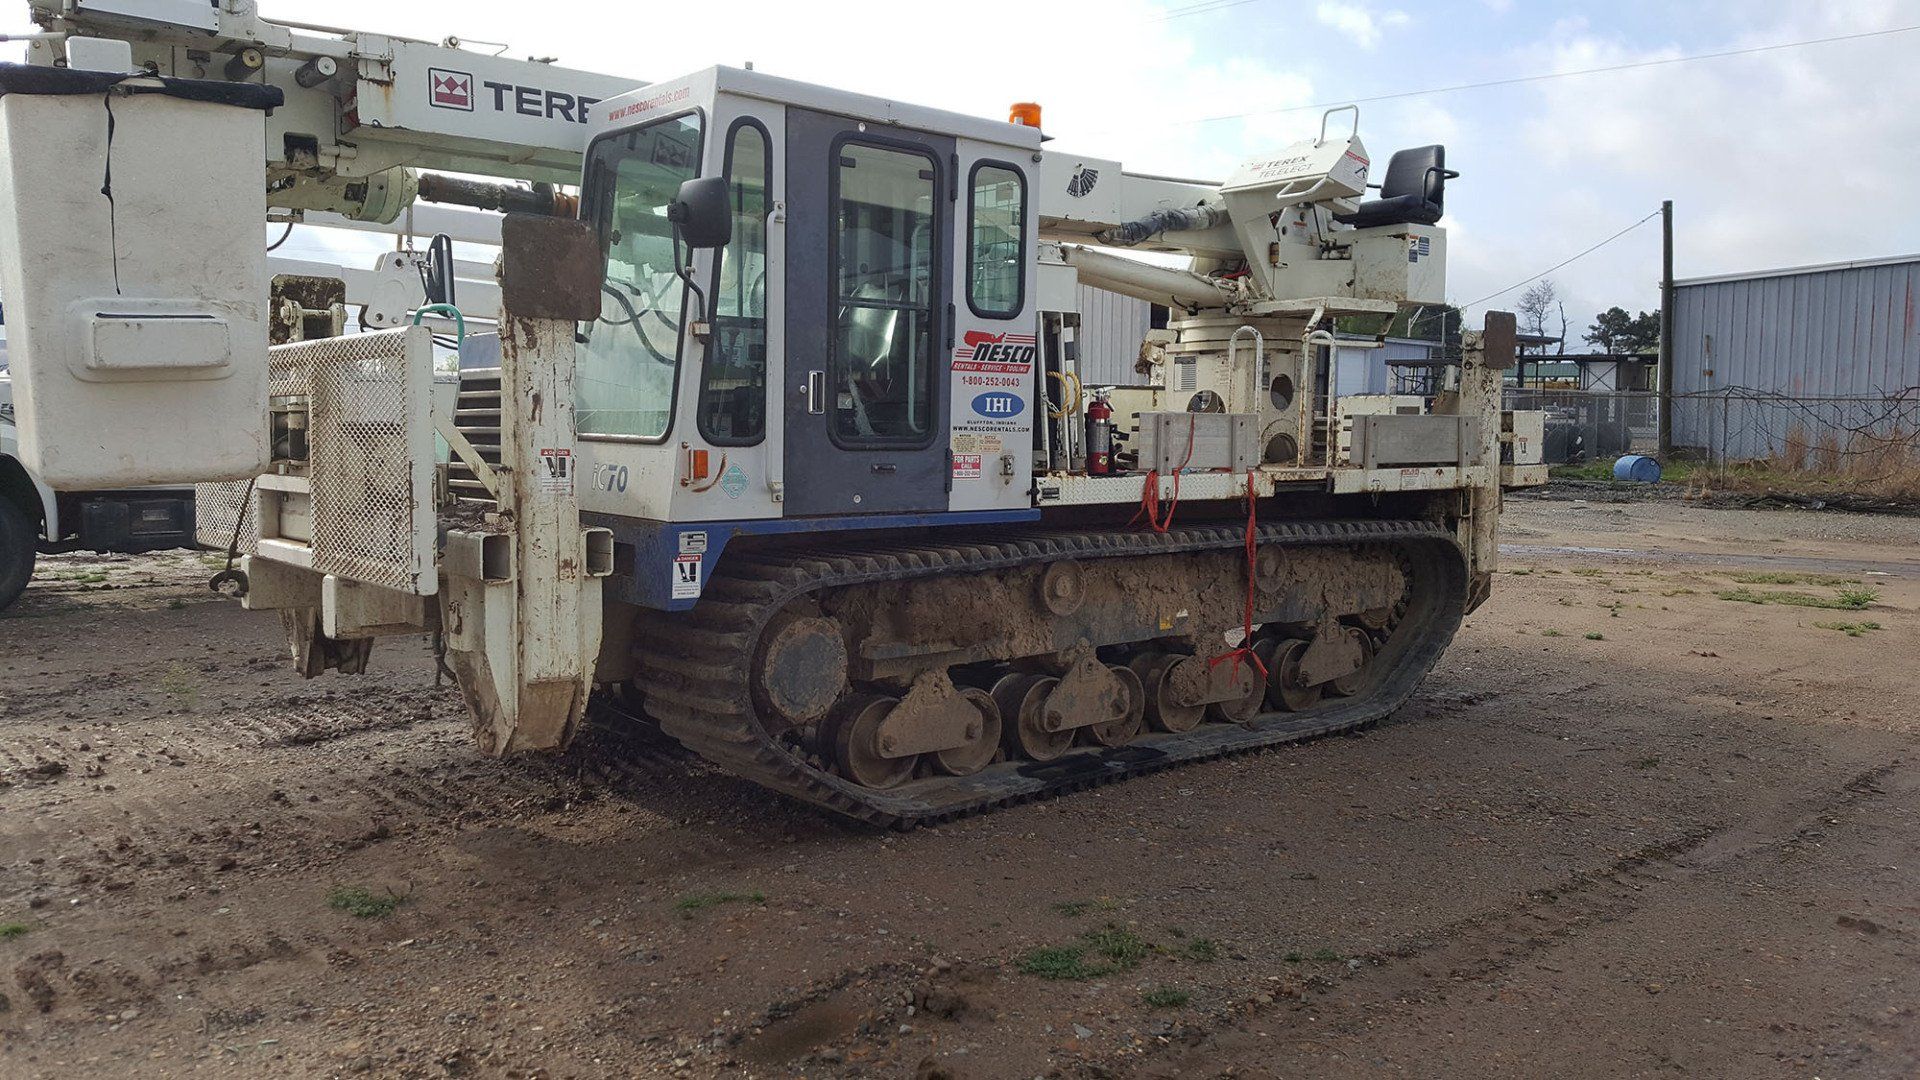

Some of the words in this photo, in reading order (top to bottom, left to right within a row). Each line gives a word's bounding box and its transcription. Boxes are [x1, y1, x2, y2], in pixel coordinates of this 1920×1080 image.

[484, 81, 602, 124] TERE
[608, 86, 691, 122] www.nescorentals.com
[1267, 155, 1310, 168] TEREX
[1259, 163, 1314, 178] TELELECT
[972, 343, 1035, 364] NESCO
[953, 362, 977, 370] RENTALS
[980, 363, 1002, 371] SERVICE
[1006, 365, 1028, 373] TOOLING
[962, 375, 1020, 387] 1-800-252-0043
[985, 397, 1012, 413] IHI
[954, 455, 964, 463] FOR
[964, 455, 980, 463] PARTS
[592, 462, 629, 493] iC70
